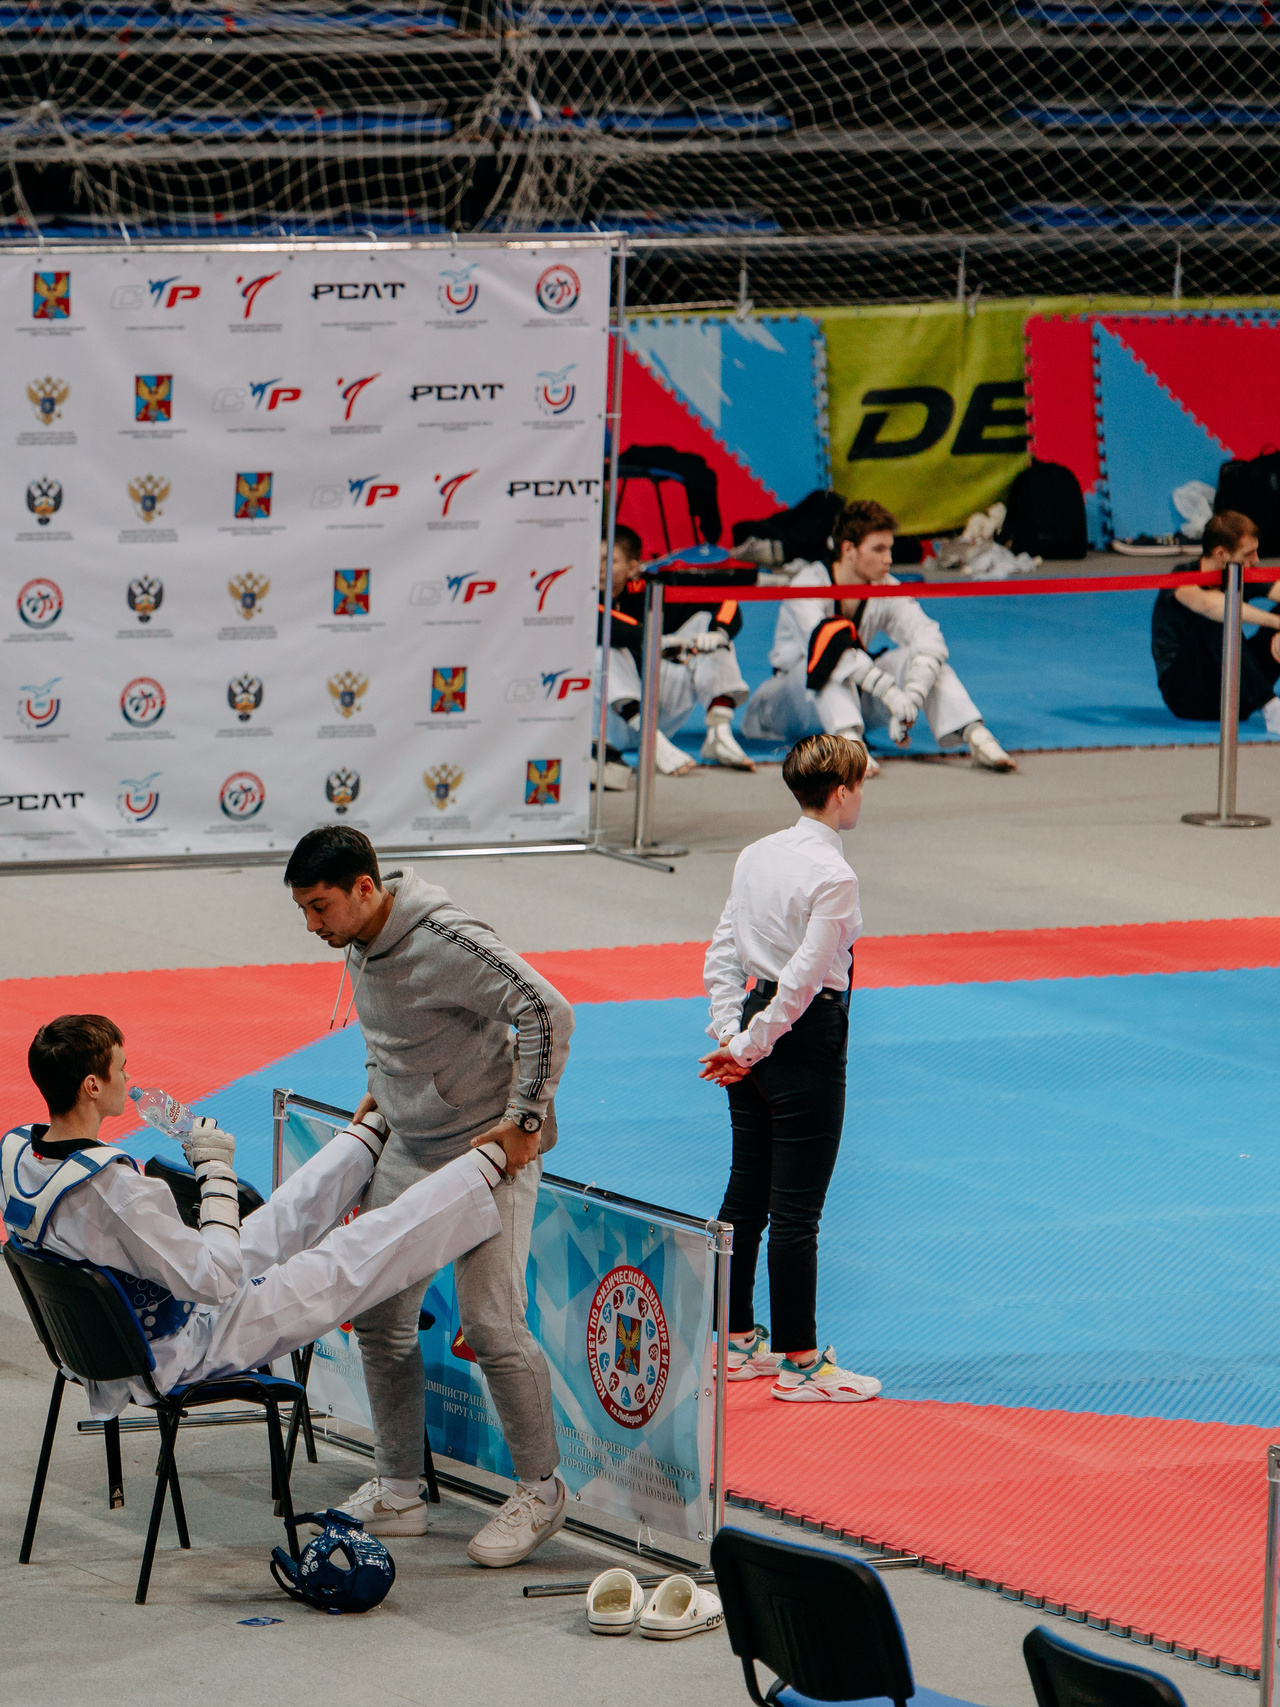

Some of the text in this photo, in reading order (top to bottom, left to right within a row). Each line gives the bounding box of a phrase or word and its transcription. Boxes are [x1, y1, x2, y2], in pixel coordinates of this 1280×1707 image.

[588, 1270, 669, 1417] КОМИТЕТ ПО ФИЗИЧЕСКОЙ КУЛЬТУРЕ И СПОРТУ
[425, 1379, 490, 1409] ДМИНИСТРАЦИЯ
[443, 1400, 473, 1420] ОКРУГА
[562, 1454, 687, 1507] ГОРОДСКОГО ОКРУГА ЛЮБЕРЦЫ
[568, 1442, 677, 1490] И СПОРТУ АДМИНИСТРАЦИИ
[591, 1433, 602, 1448] ПО
[603, 1438, 653, 1469] ФИЗИЧЕСКОЙ
[653, 1455, 695, 1482] КУЛЬТУРЕ
